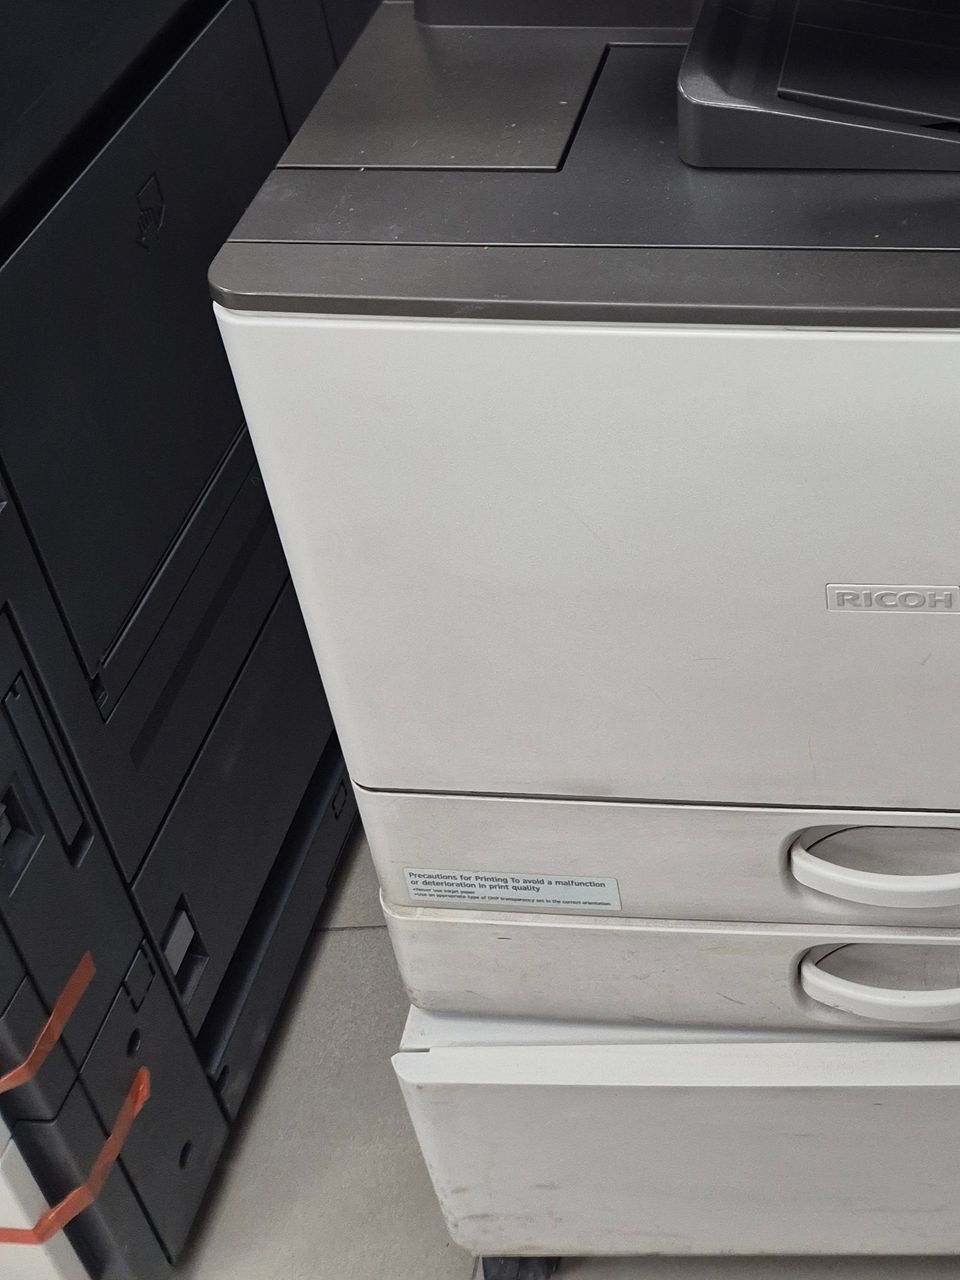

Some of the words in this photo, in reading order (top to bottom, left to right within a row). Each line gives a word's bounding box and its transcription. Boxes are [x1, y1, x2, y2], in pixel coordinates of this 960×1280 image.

[835, 590, 953, 609] RICOH
[409, 872, 457, 880] Precautions
[475, 876, 508, 884] Printing
[422, 880, 476, 888] deterioration
